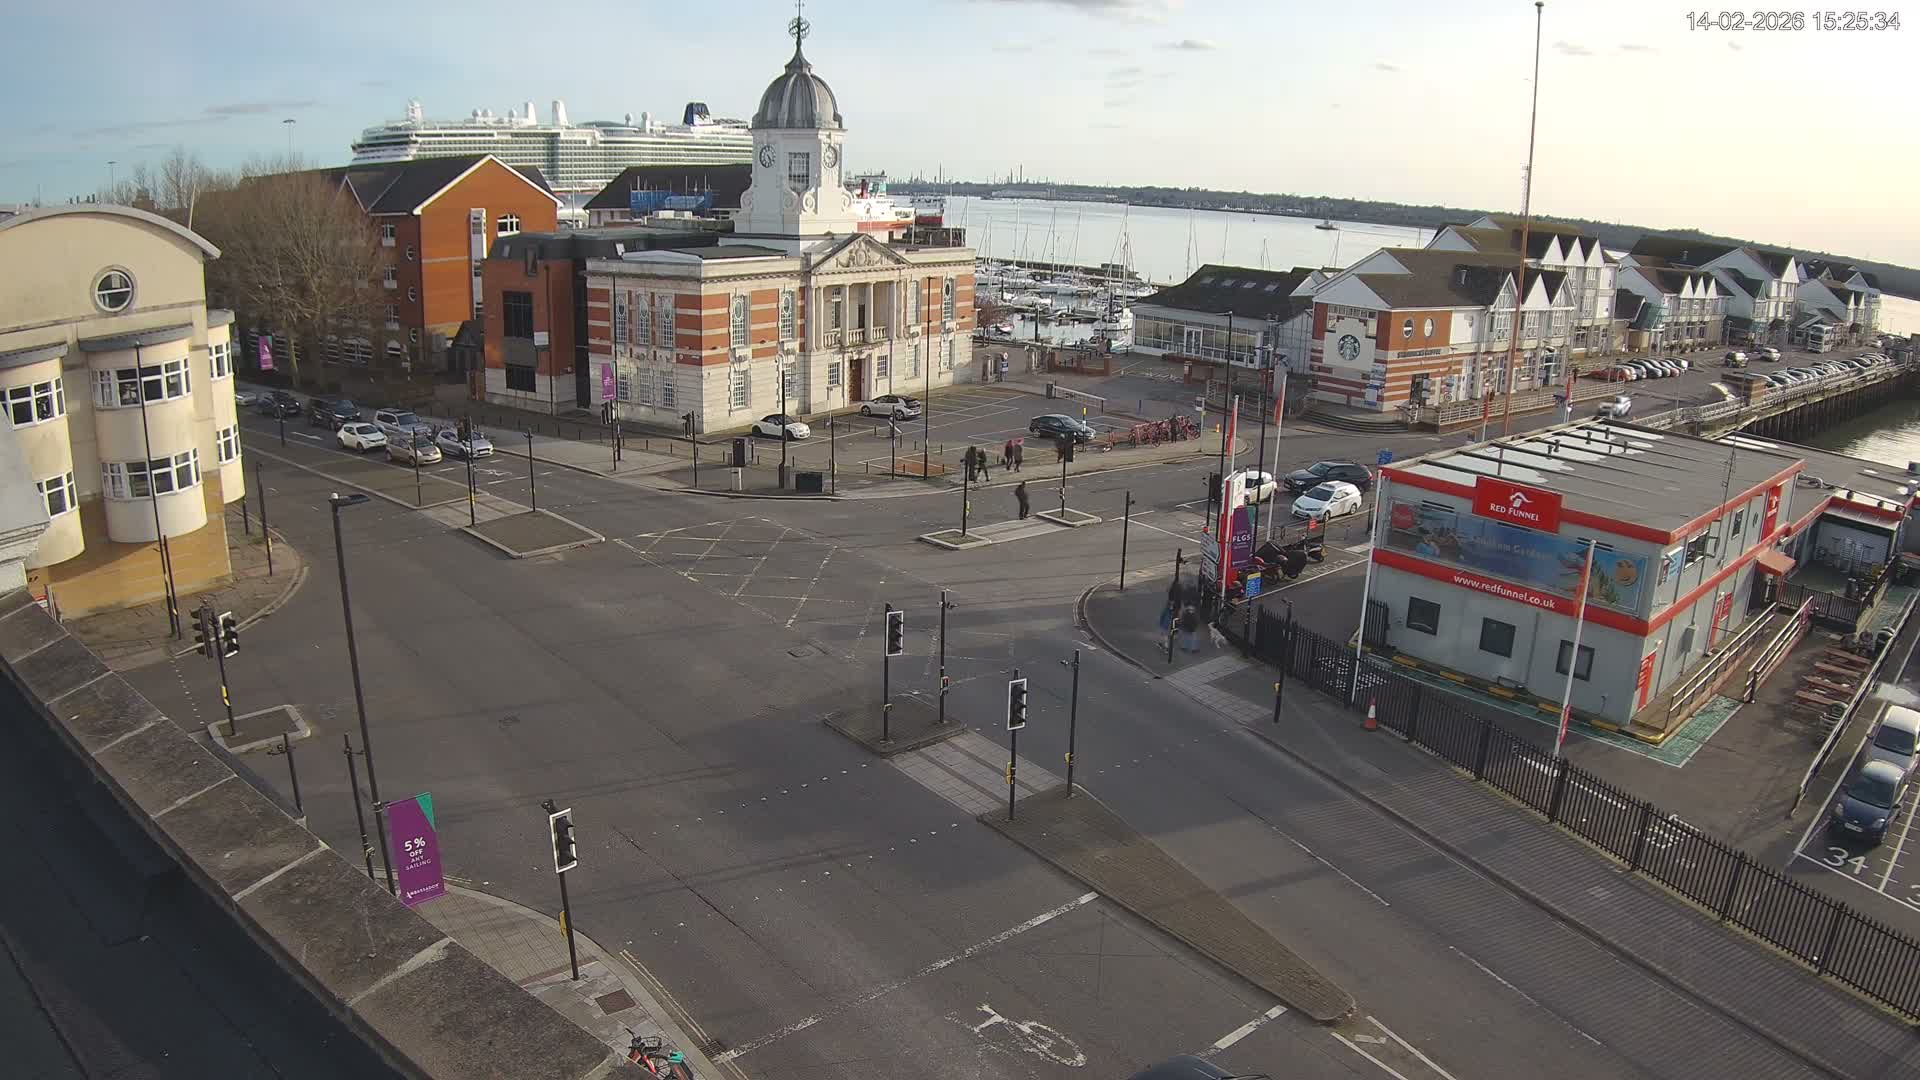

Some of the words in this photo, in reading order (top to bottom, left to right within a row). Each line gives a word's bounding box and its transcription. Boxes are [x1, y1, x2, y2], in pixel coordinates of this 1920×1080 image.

[1490, 503, 1506, 513] RED
[1508, 507, 1541, 521] FUNNEL
[1453, 575, 1555, 608] www.redfunnel.co.uk
[409, 849, 423, 857] OFF
[411, 855, 424, 863] ANY
[406, 859, 431, 870] SAILING
[1823, 847, 1869, 875] 34
